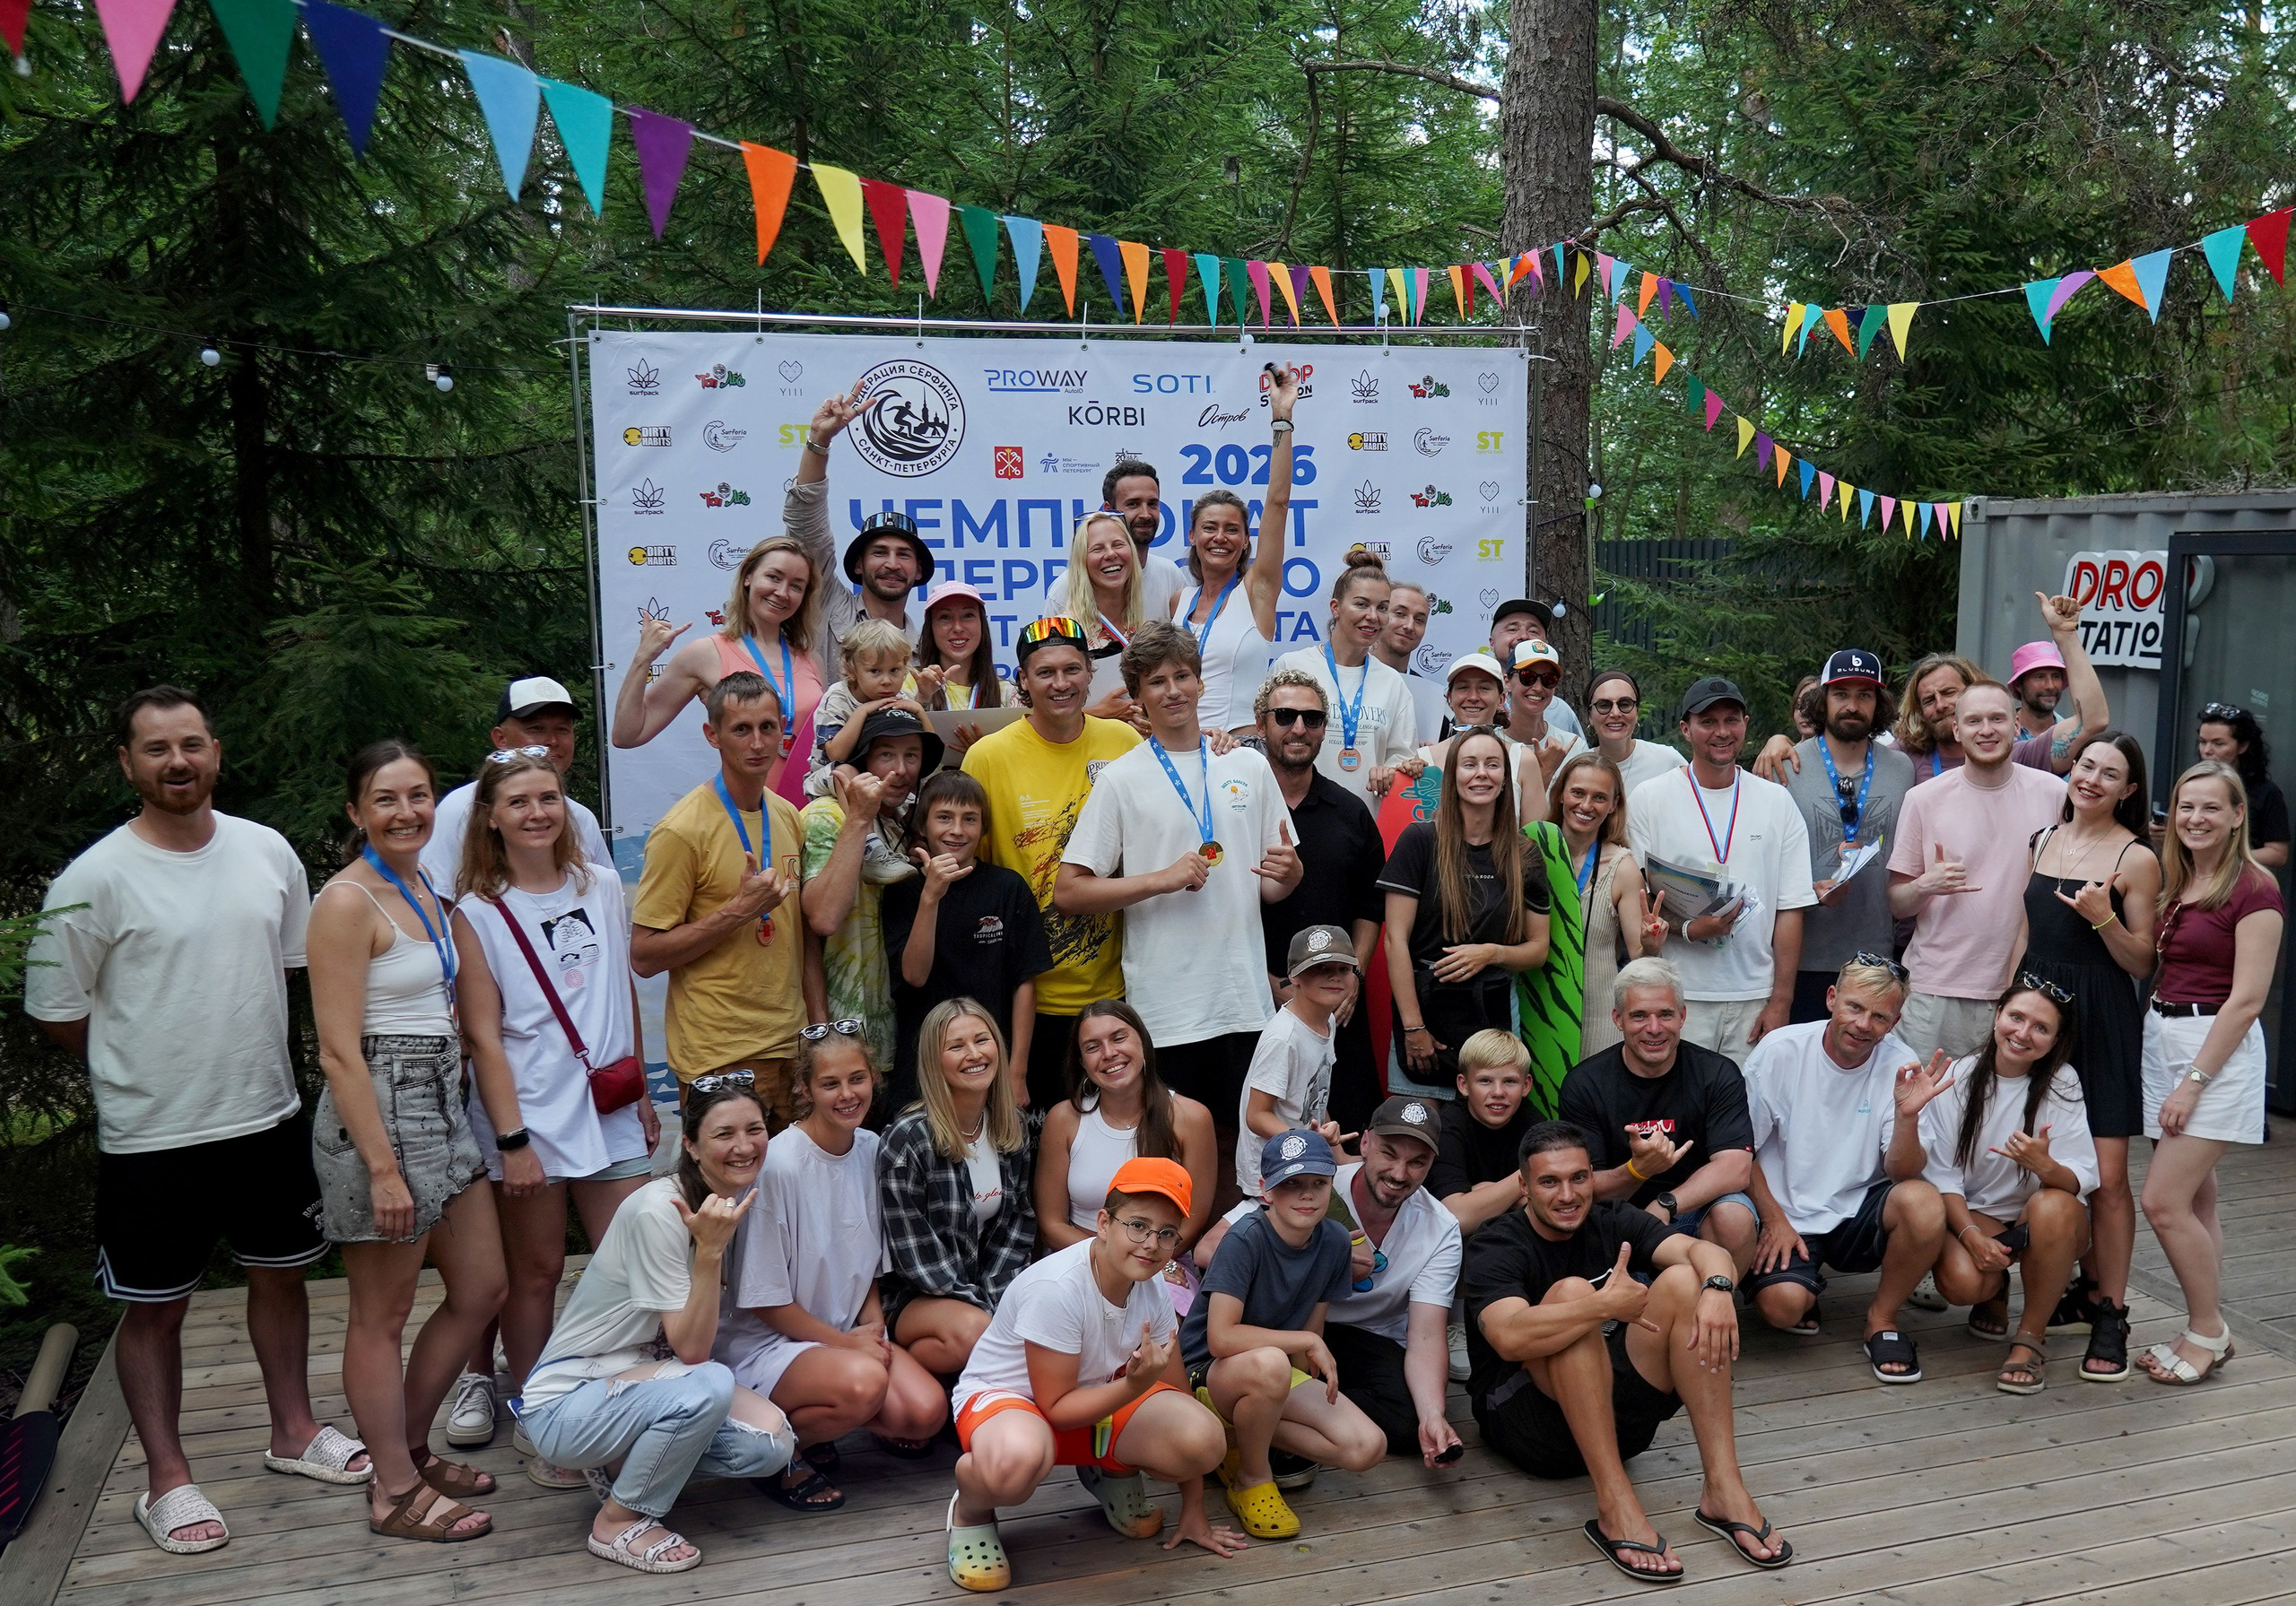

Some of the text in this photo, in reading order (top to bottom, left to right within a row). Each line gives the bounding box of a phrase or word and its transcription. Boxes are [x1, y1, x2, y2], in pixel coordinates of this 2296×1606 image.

[983, 369, 1088, 386] PROWAY
[1133, 374, 1211, 393] SOTI
[1259, 364, 1313, 393] DOP
[909, 365, 958, 411] СЕРФИНГА
[1197, 404, 1250, 432] Остров
[641, 426, 671, 437] DIRTY
[778, 423, 811, 444] ST
[1363, 431, 1387, 442] DIRTY
[1476, 431, 1504, 450] ST
[641, 437, 672, 447] HABITS
[1363, 441, 1387, 451] HABITS
[858, 438, 957, 473] САНКТ-ПЕТЕРБУРГА
[1178, 444, 1317, 485] 2026
[647, 545, 676, 556] DIRTY
[1365, 543, 1390, 552] DIRTY
[1477, 539, 1504, 557] ST
[647, 556, 677, 566] HABITS
[2068, 560, 2165, 613] DRO
[2075, 621, 2163, 657] TATIO
